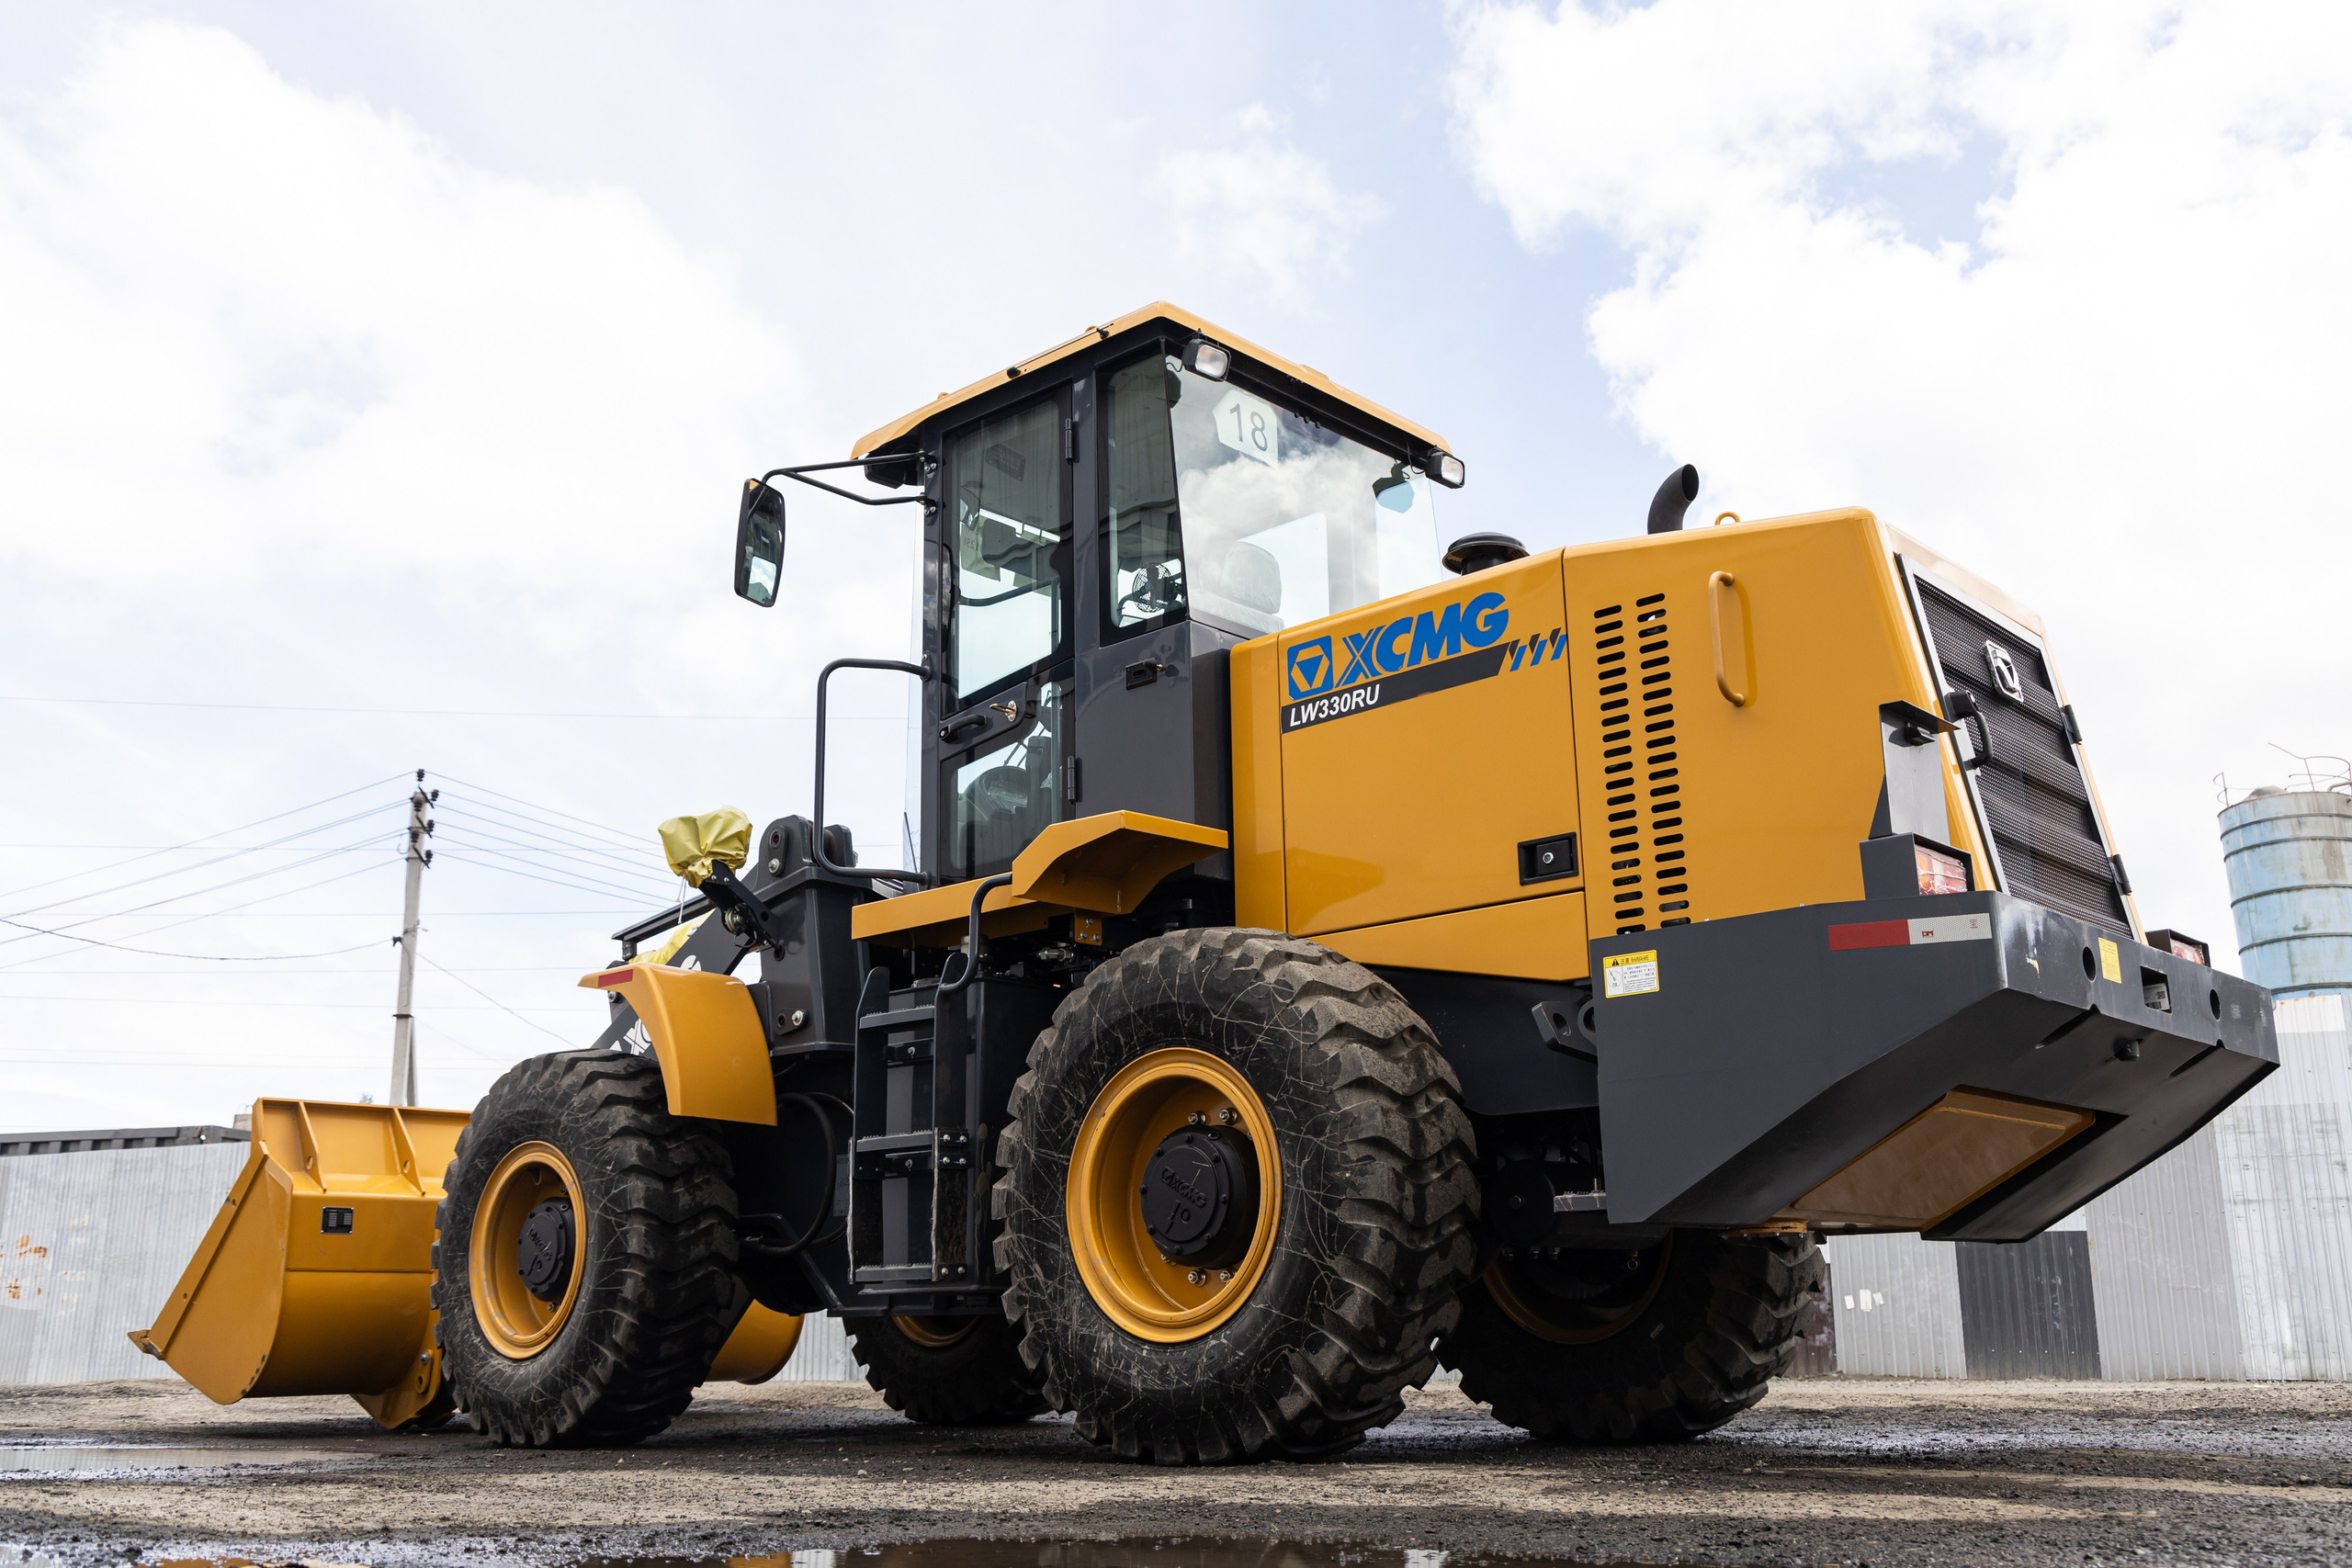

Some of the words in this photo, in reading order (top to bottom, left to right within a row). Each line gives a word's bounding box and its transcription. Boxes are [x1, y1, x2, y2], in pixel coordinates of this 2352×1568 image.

[1229, 403, 1268, 452] 18
[1335, 592, 1510, 689] XCMG
[1289, 683, 1381, 728] LW330RU
[1170, 1176, 1207, 1208] XCMG
